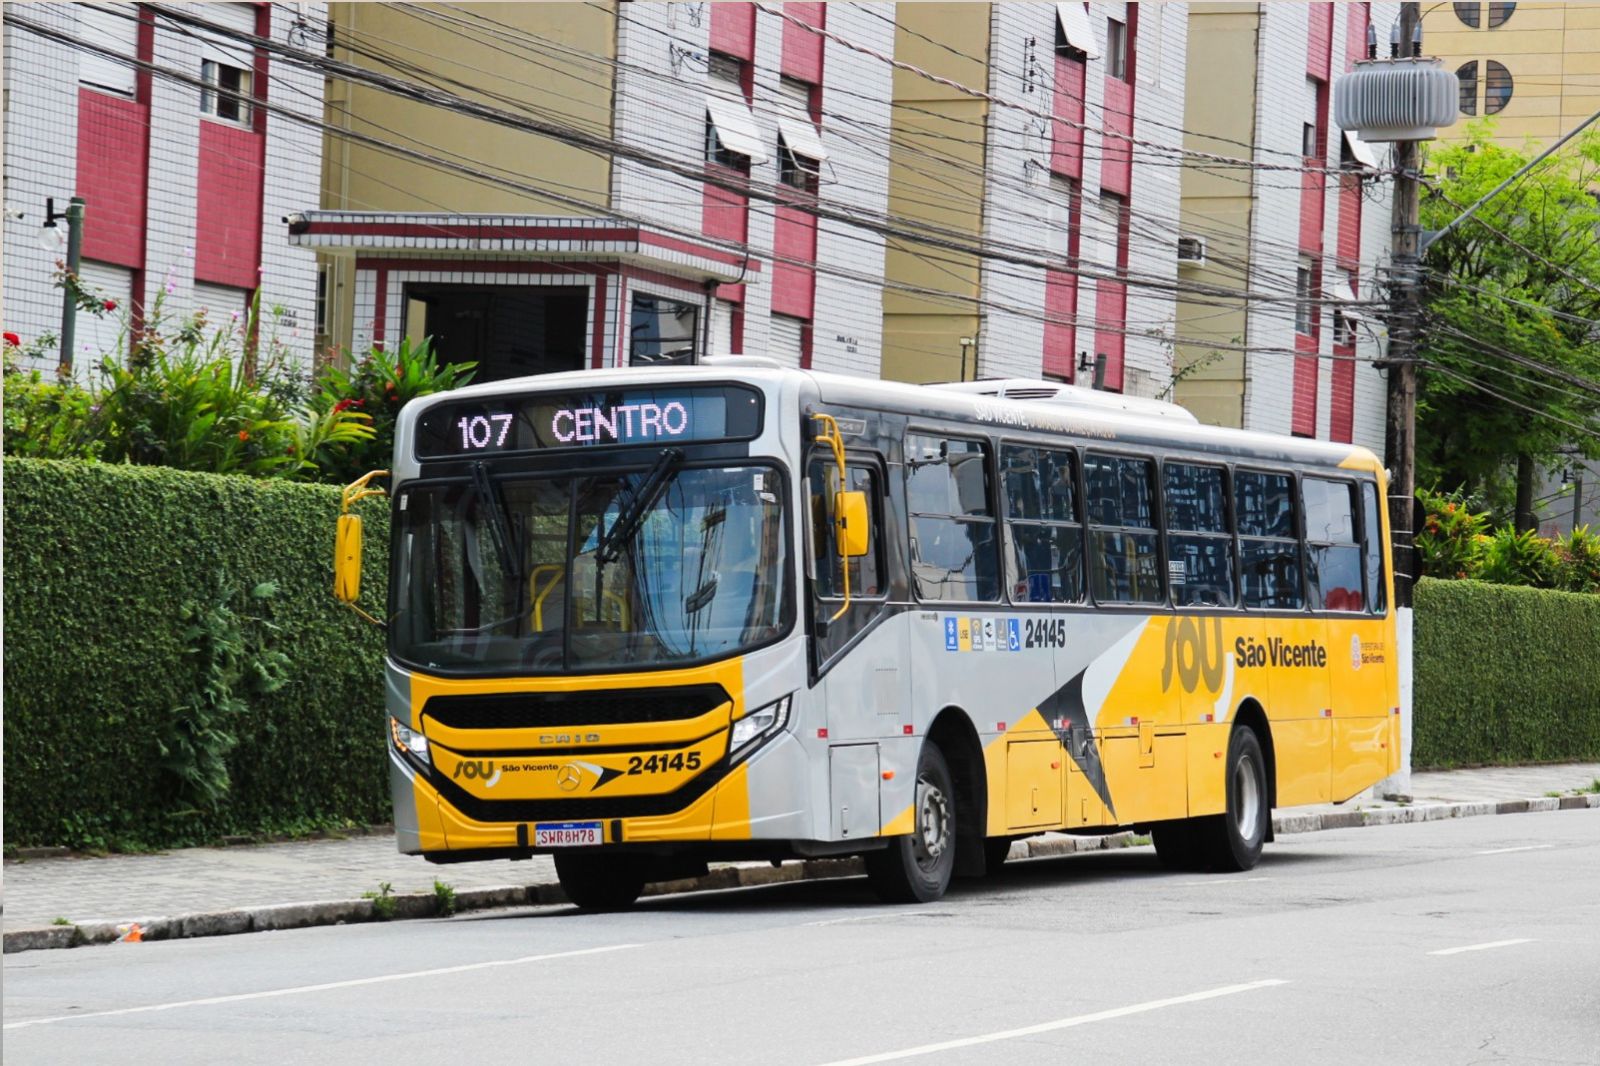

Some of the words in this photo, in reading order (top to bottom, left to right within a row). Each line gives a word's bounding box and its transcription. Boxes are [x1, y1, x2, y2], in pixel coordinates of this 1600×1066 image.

[458, 413, 513, 449] 107
[552, 402, 688, 442] CENTRO
[1025, 619, 1066, 648] 24145
[1235, 636, 1267, 668] São
[1268, 637, 1327, 668] Vicente
[502, 763, 520, 773] São
[522, 763, 559, 772] Vicente
[627, 751, 702, 776] 24145
[541, 829, 595, 844] SWR8H78
